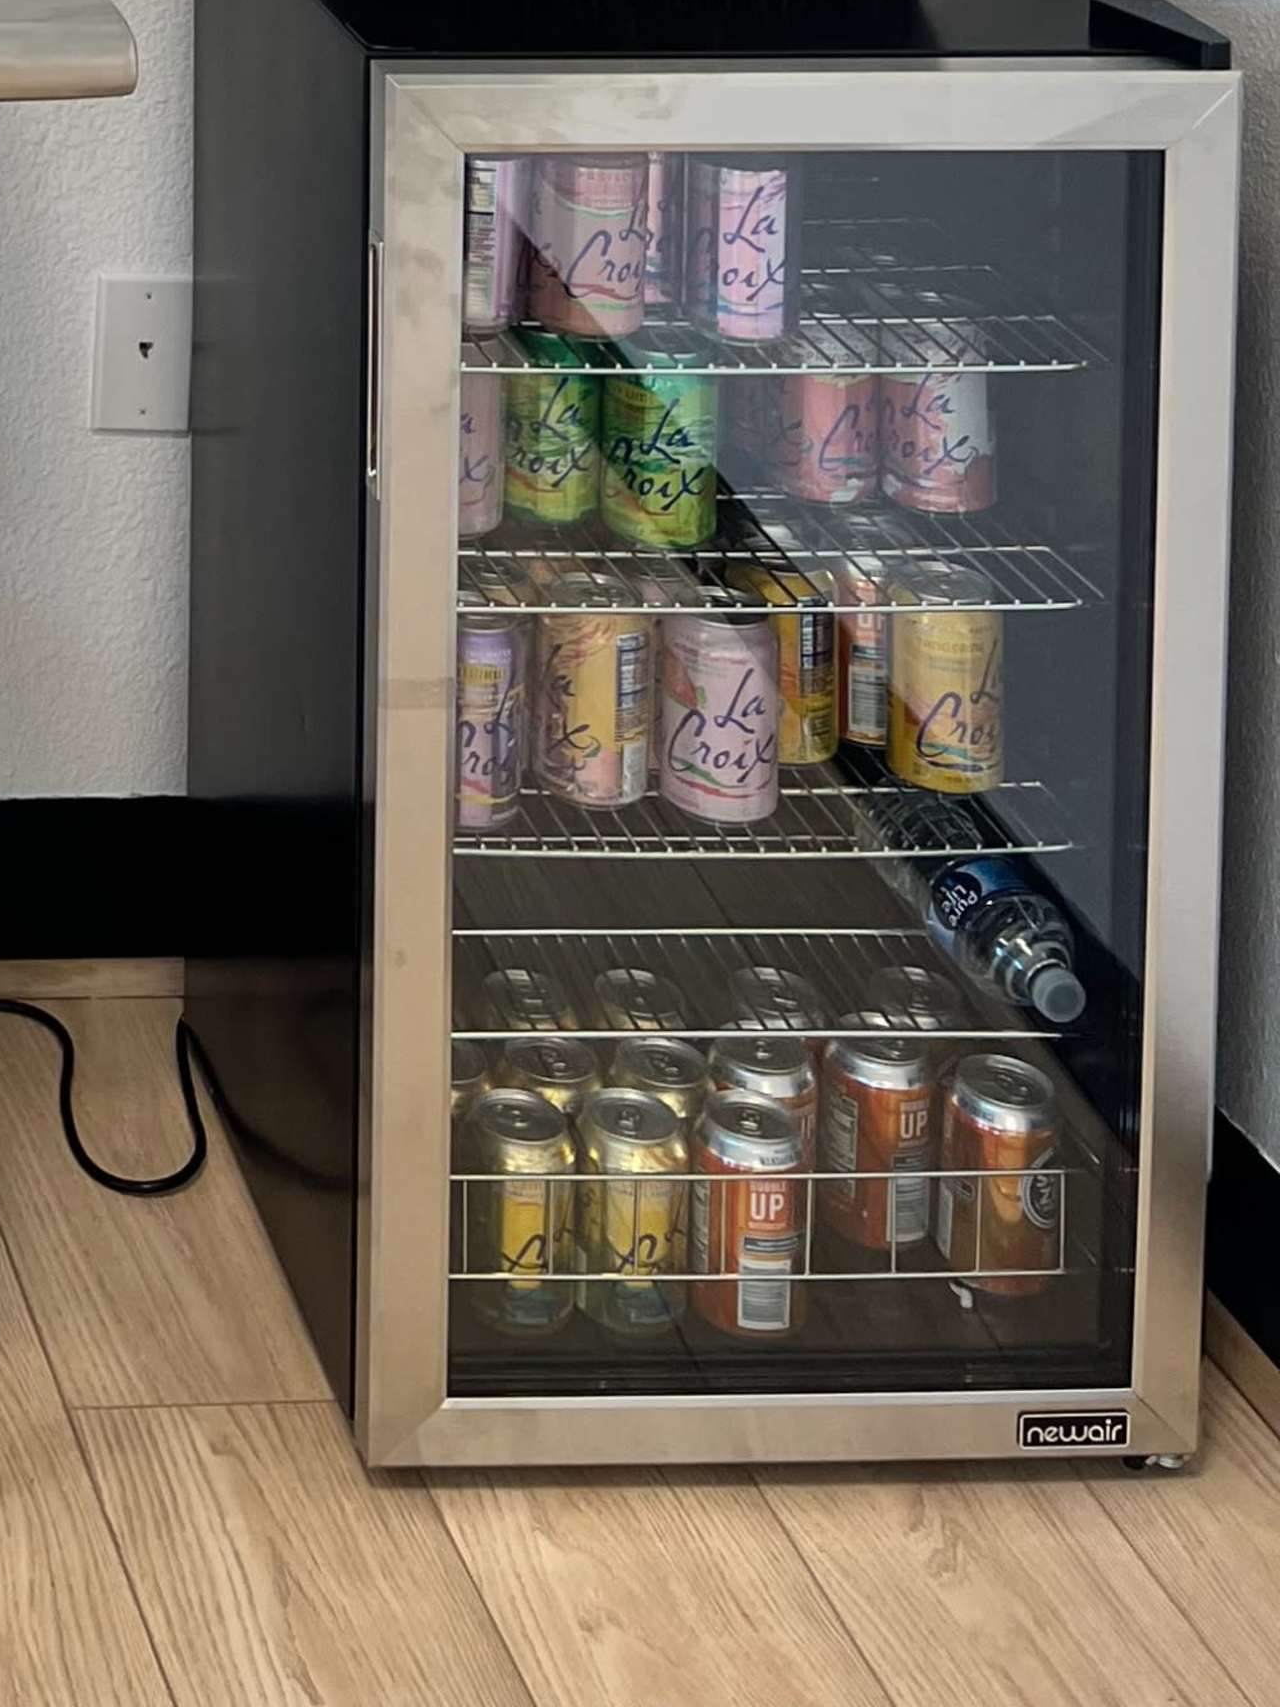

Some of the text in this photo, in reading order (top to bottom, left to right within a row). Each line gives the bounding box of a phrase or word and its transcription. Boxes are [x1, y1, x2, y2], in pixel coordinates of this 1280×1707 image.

[723, 186, 778, 253] La
[531, 376, 583, 442] La
[639, 397, 695, 465] La
[714, 667, 767, 735] La
[668, 708, 775, 784] Croix
[940, 884, 968, 914] Life
[948, 890, 979, 928] Pure
[900, 1110, 929, 1140] UP
[750, 1192, 785, 1222] UP
[1026, 1418, 1123, 1443] newair
